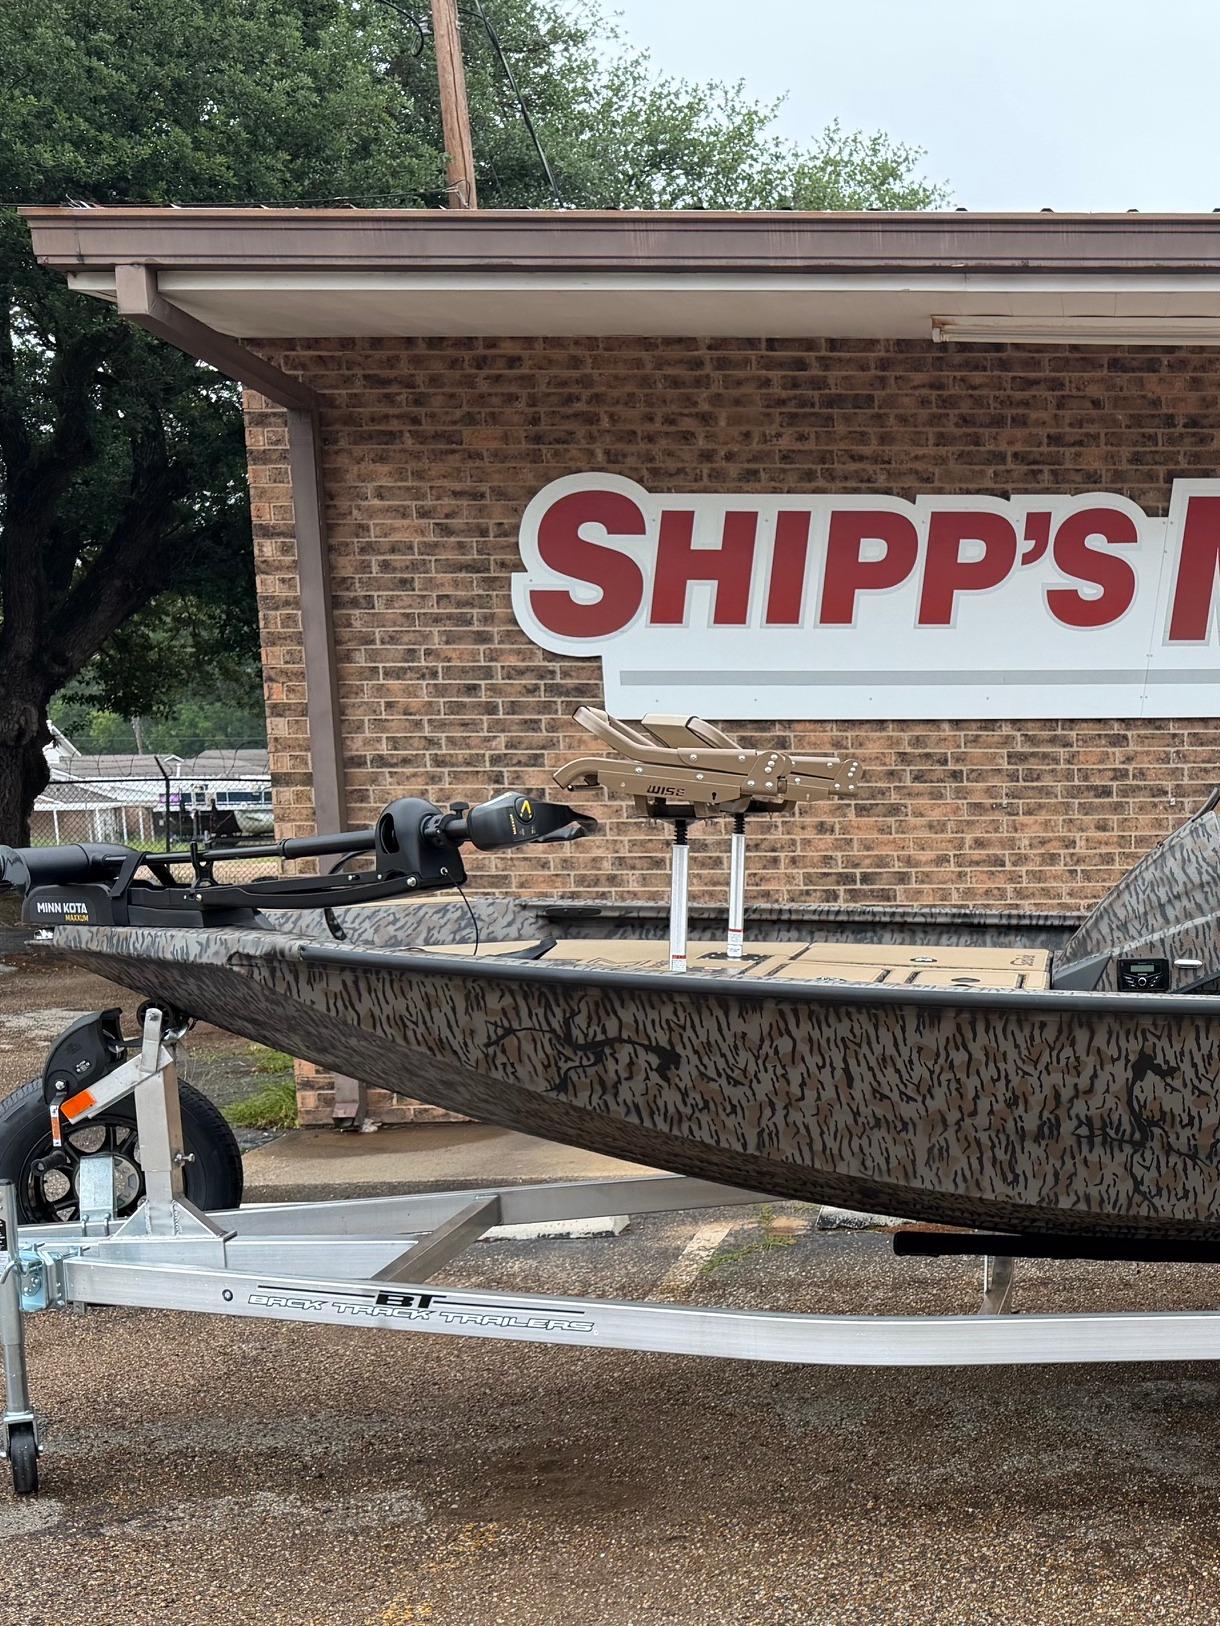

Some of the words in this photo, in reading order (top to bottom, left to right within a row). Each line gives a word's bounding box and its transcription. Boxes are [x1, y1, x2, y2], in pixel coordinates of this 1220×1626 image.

[529, 489, 1139, 638] SHIPP'S
[646, 784, 686, 797] WISE
[36, 902, 61, 913] MINN
[63, 902, 88, 914] KOTA
[375, 1290, 447, 1309] BT
[248, 1294, 328, 1311] BACK
[332, 1301, 436, 1321] TRACK
[439, 1311, 595, 1333] TRAILERS
